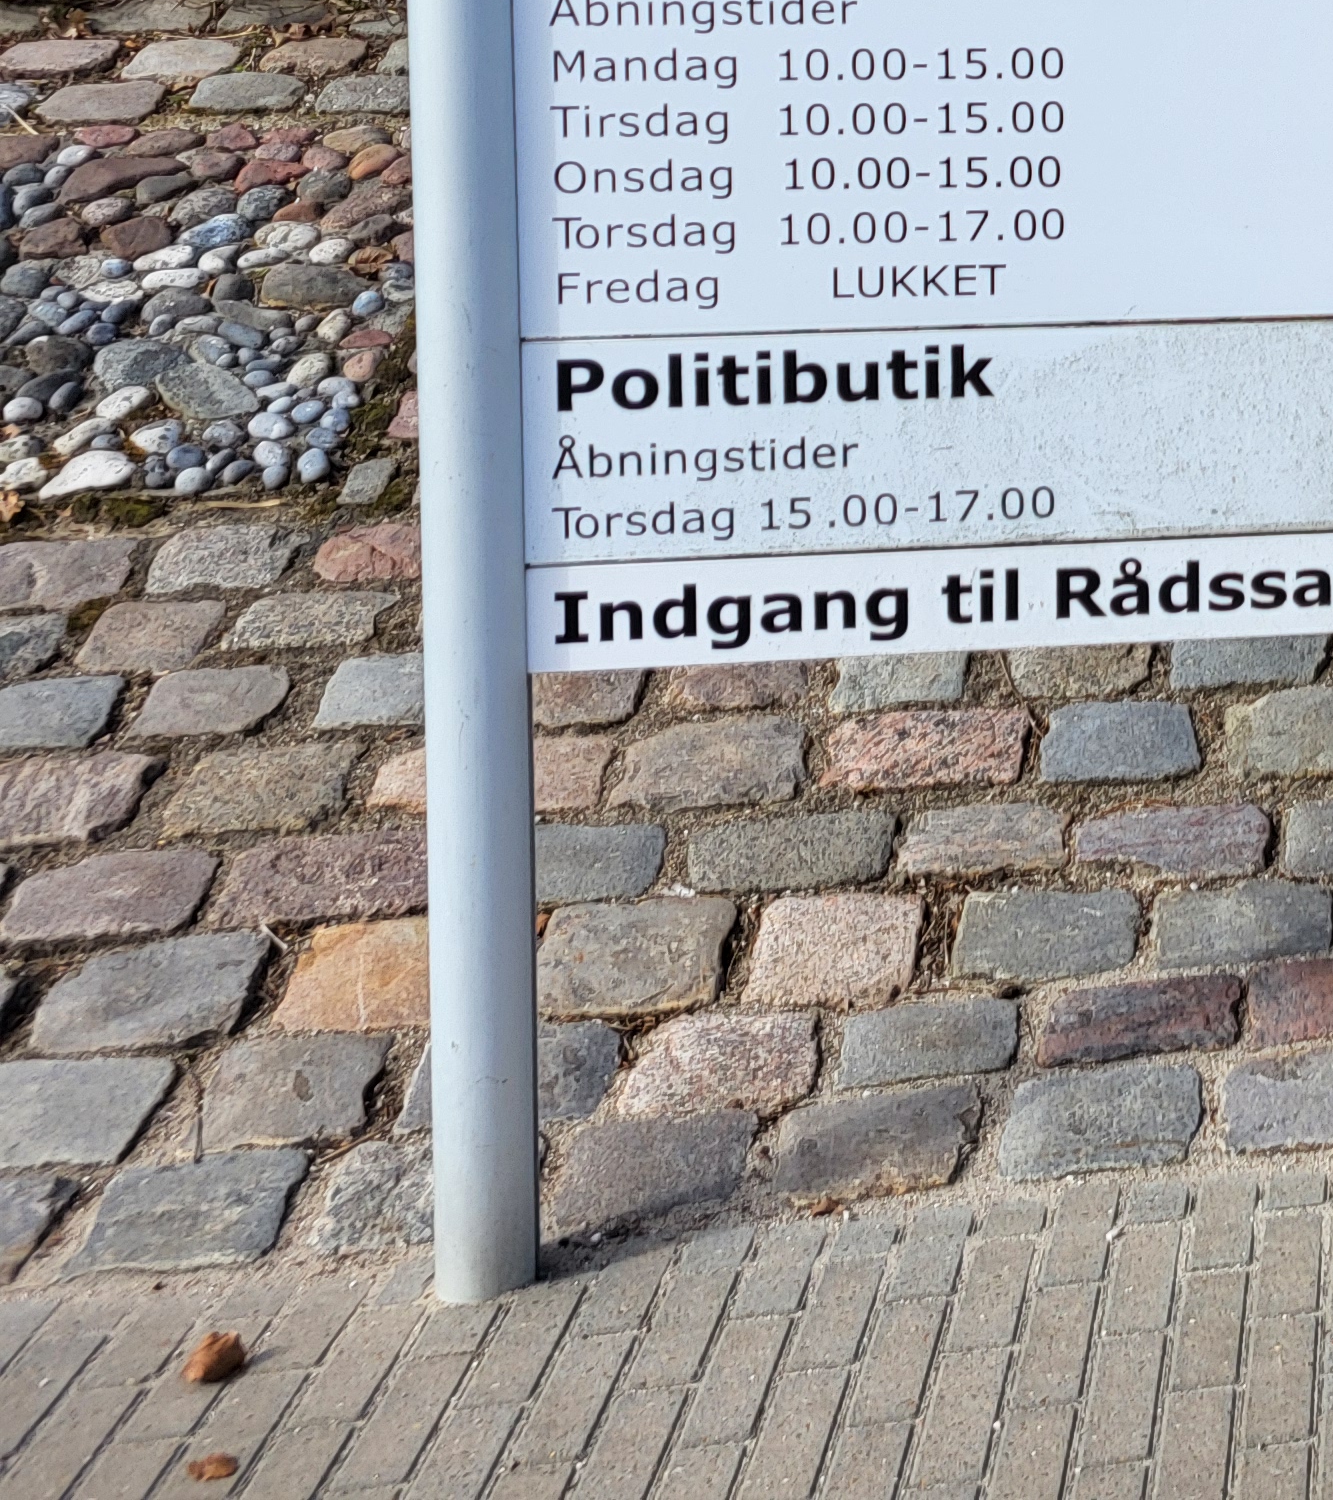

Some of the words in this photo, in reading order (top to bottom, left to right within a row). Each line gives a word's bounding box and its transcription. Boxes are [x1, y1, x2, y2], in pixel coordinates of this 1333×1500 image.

[553, 47, 738, 89] Mandag
[779, 46, 1065, 83] 10.00-15.00
[550, 103, 730, 146] Tirsdag
[780, 100, 1065, 137] 10.00-15.00
[553, 158, 734, 201] Onsdag
[785, 155, 1062, 191] 10.00-15.00
[551, 213, 737, 256] Torsdag
[781, 208, 1066, 247] 10.00-17.00
[556, 269, 720, 311] Fredag
[833, 263, 1007, 299] LUKKET
[555, 344, 995, 412] Politibutik
[551, 434, 859, 483] Åbningstider
[551, 501, 735, 542] Torsdag
[554, 583, 909, 650] Indgang
[941, 568, 1019, 624] til
